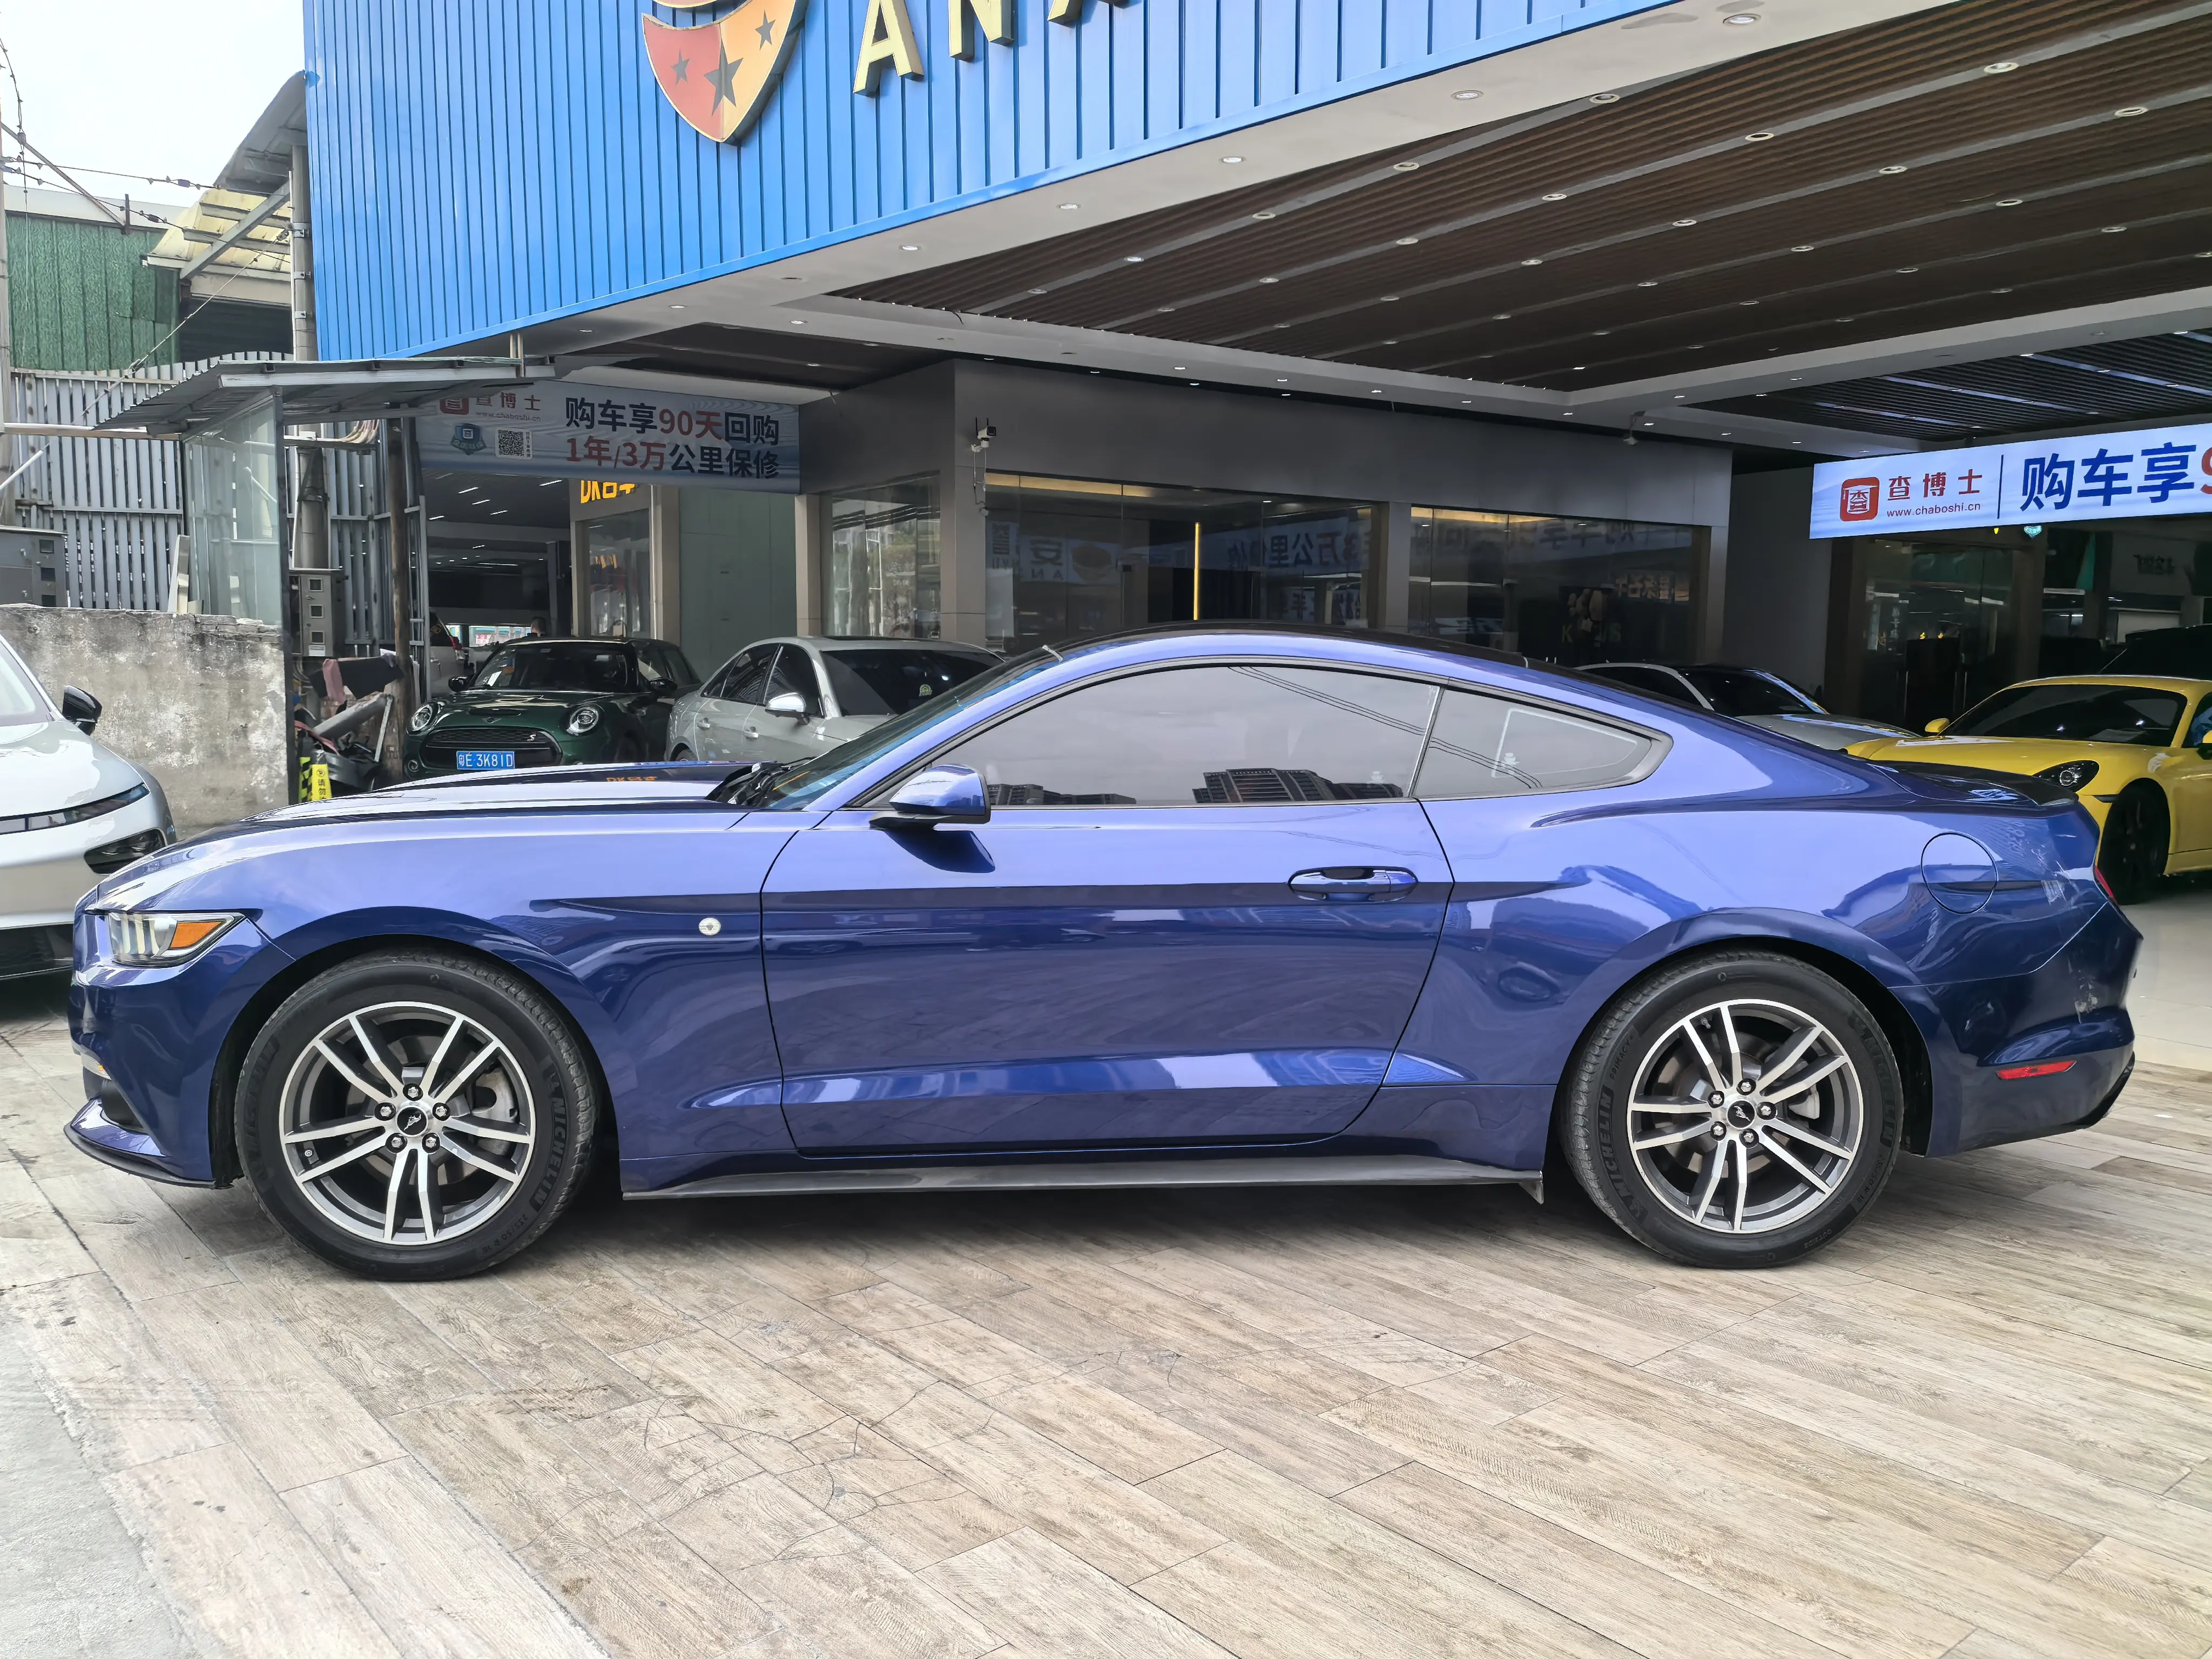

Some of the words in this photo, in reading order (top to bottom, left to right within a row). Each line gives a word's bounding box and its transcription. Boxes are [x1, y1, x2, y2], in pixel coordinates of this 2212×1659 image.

[565, 396, 779, 444] 购车享90天回购
[565, 435, 780, 479] 1年/3万公里保修
[1887, 468, 1983, 501] 查博士
[1886, 502, 1981, 518] www.chaboshi.cn
[318, 779, 326, 799] 请勿
[534, 1097, 567, 1206] MICHELIN
[1599, 1092, 1632, 1197] MICHELIN
[501, 1213, 529, 1240] 235/50
